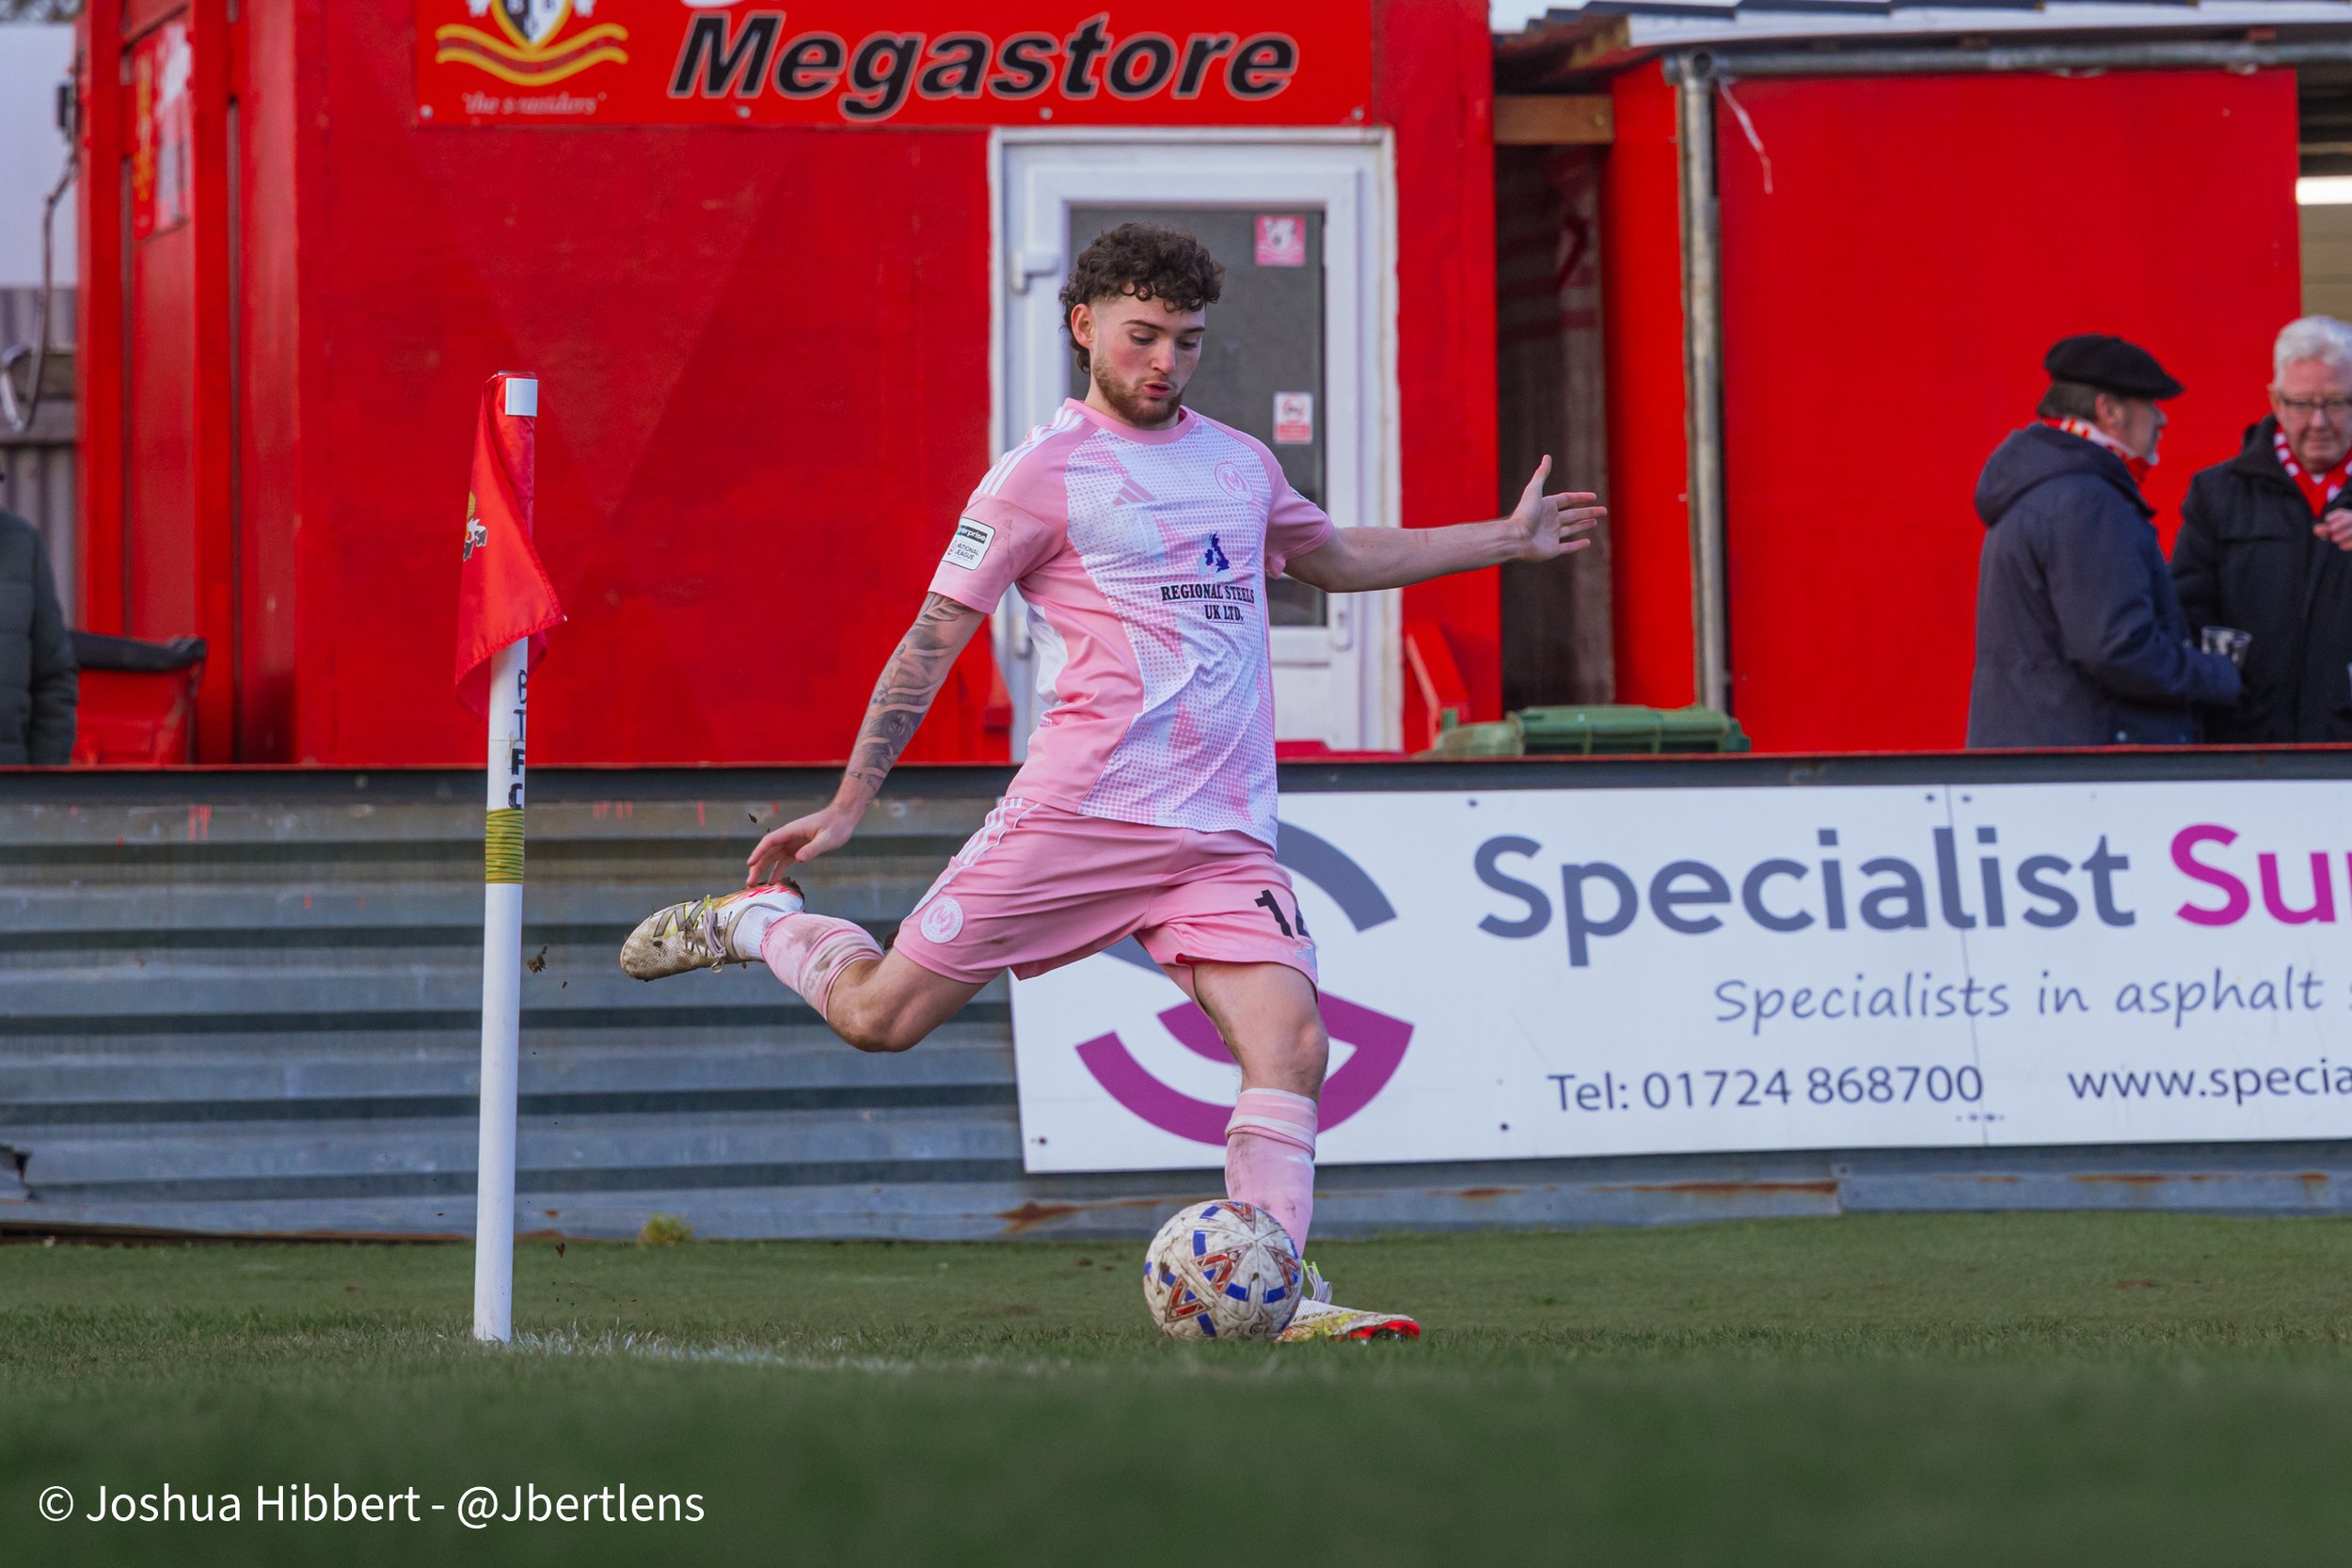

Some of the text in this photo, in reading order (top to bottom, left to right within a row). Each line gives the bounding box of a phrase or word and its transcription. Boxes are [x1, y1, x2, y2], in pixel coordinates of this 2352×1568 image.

[667, 9, 1299, 120] Megastore
[957, 543, 979, 557] ATIONAL
[960, 527, 986, 542] erprise
[1160, 583, 1255, 604] REGIONAL STEELS
[1204, 604, 1244, 621] UK LTD.
[1473, 825, 2137, 968] Specialist
[1715, 972, 2009, 1036] Specialists
[2039, 971, 2089, 1015] in
[2116, 966, 2323, 1028] asphalt
[1547, 1071, 1629, 1112] Tel:
[1643, 1069, 1792, 1110] 01724
[1807, 1065, 1984, 1104] 868700
